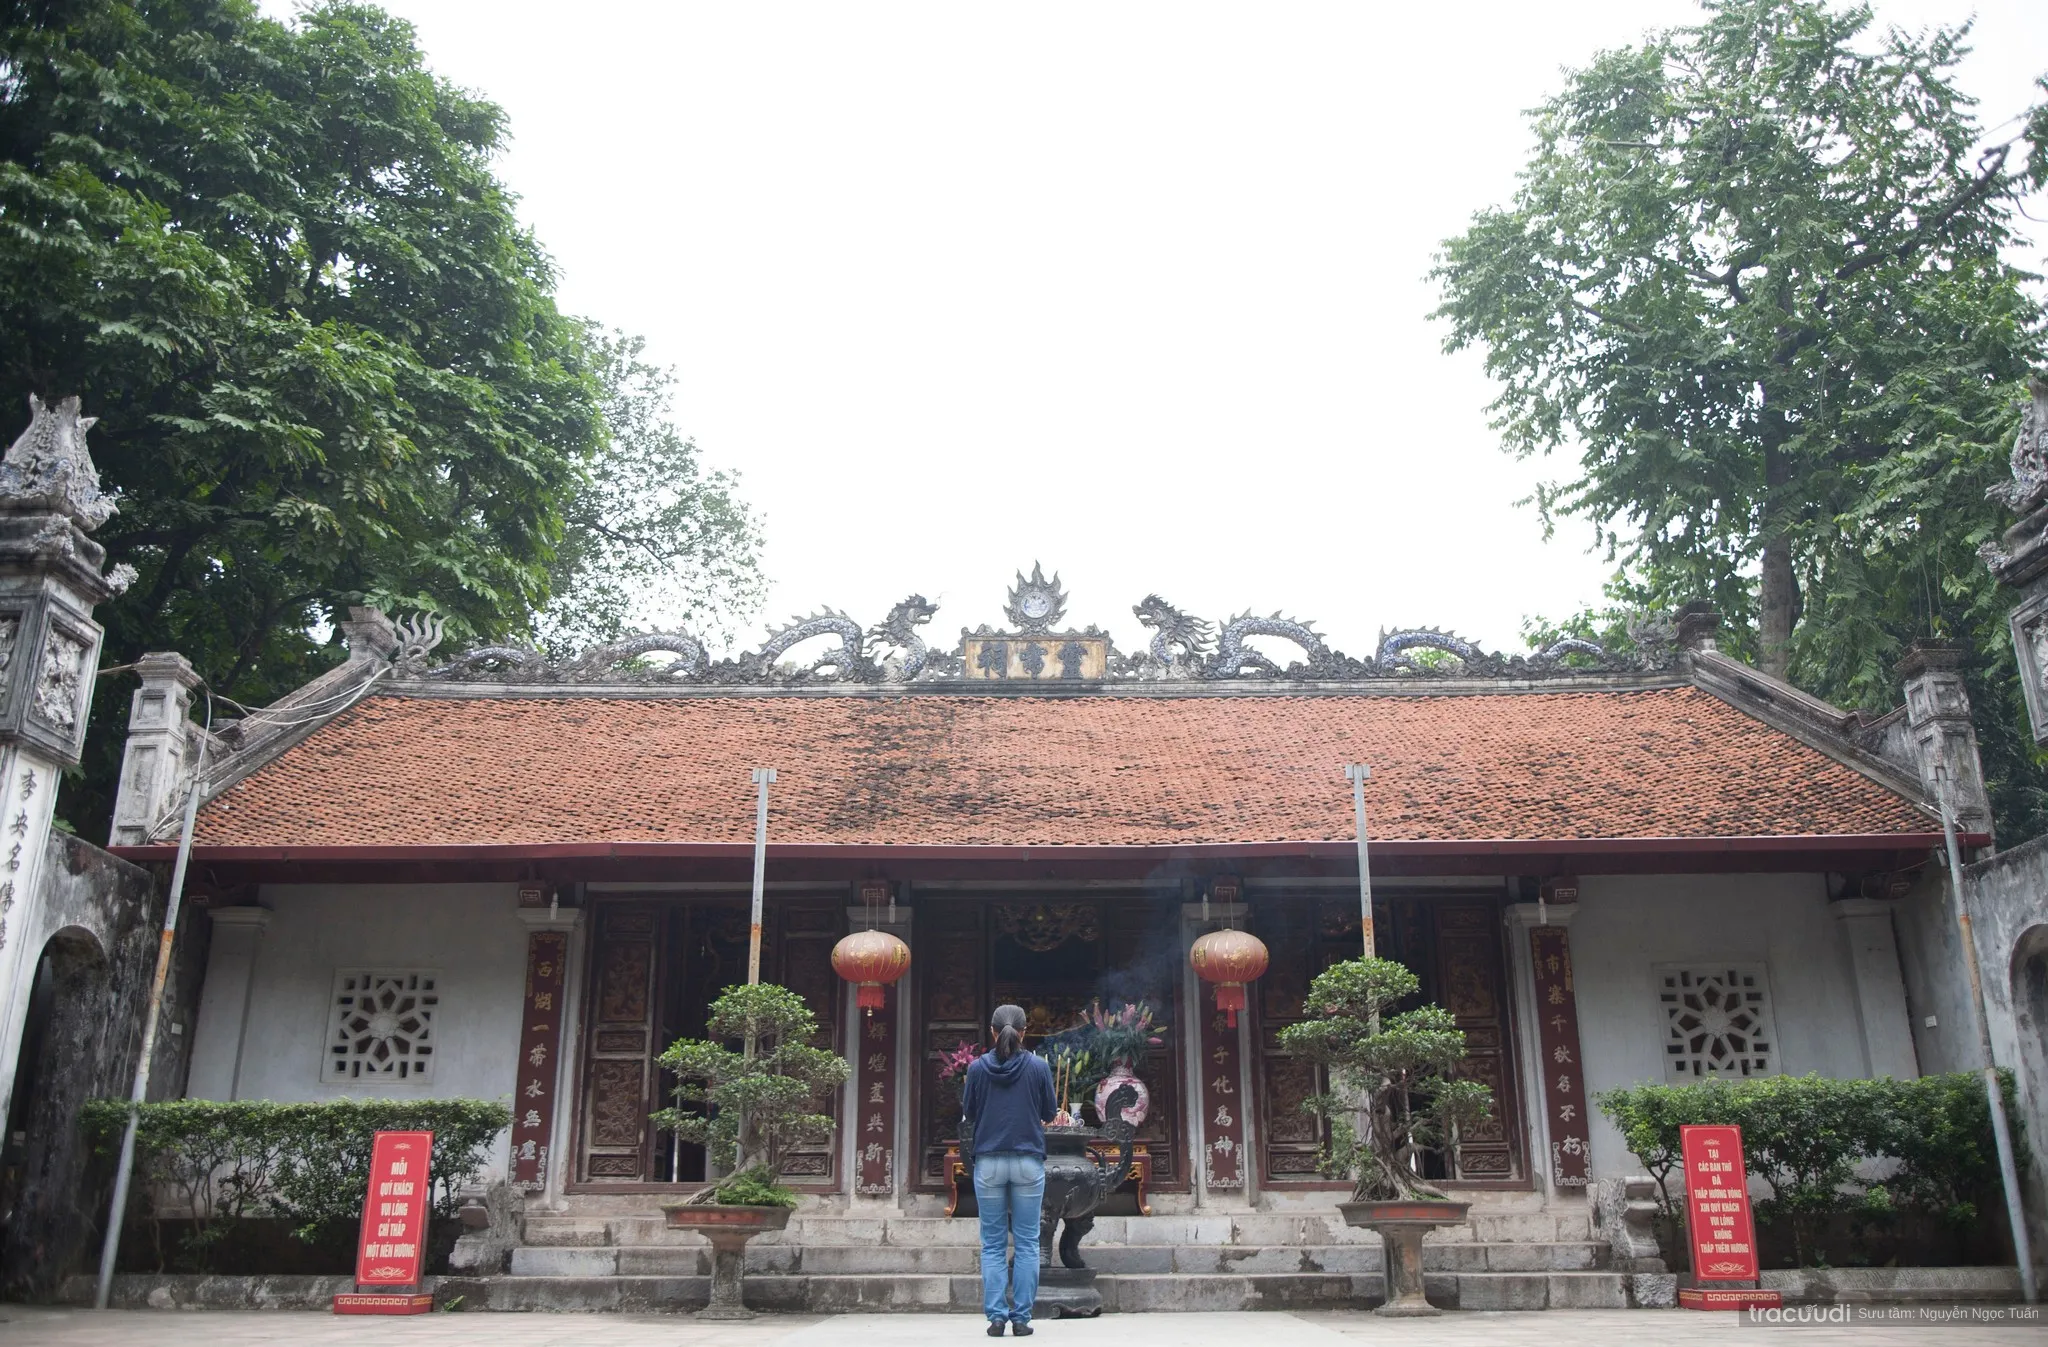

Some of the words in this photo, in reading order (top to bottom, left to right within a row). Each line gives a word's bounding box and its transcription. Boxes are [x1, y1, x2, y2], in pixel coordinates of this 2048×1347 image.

[1708, 1149, 1719, 1160] TẠI
[1698, 1160, 1709, 1172] CÁC
[380, 1179, 393, 1197] QUÝ
[392, 1179, 414, 1196] KHÁCH
[381, 1202, 391, 1217] VUI
[1721, 1201, 1740, 1212] KHÁCH
[1710, 1216, 1719, 1226] VUI
